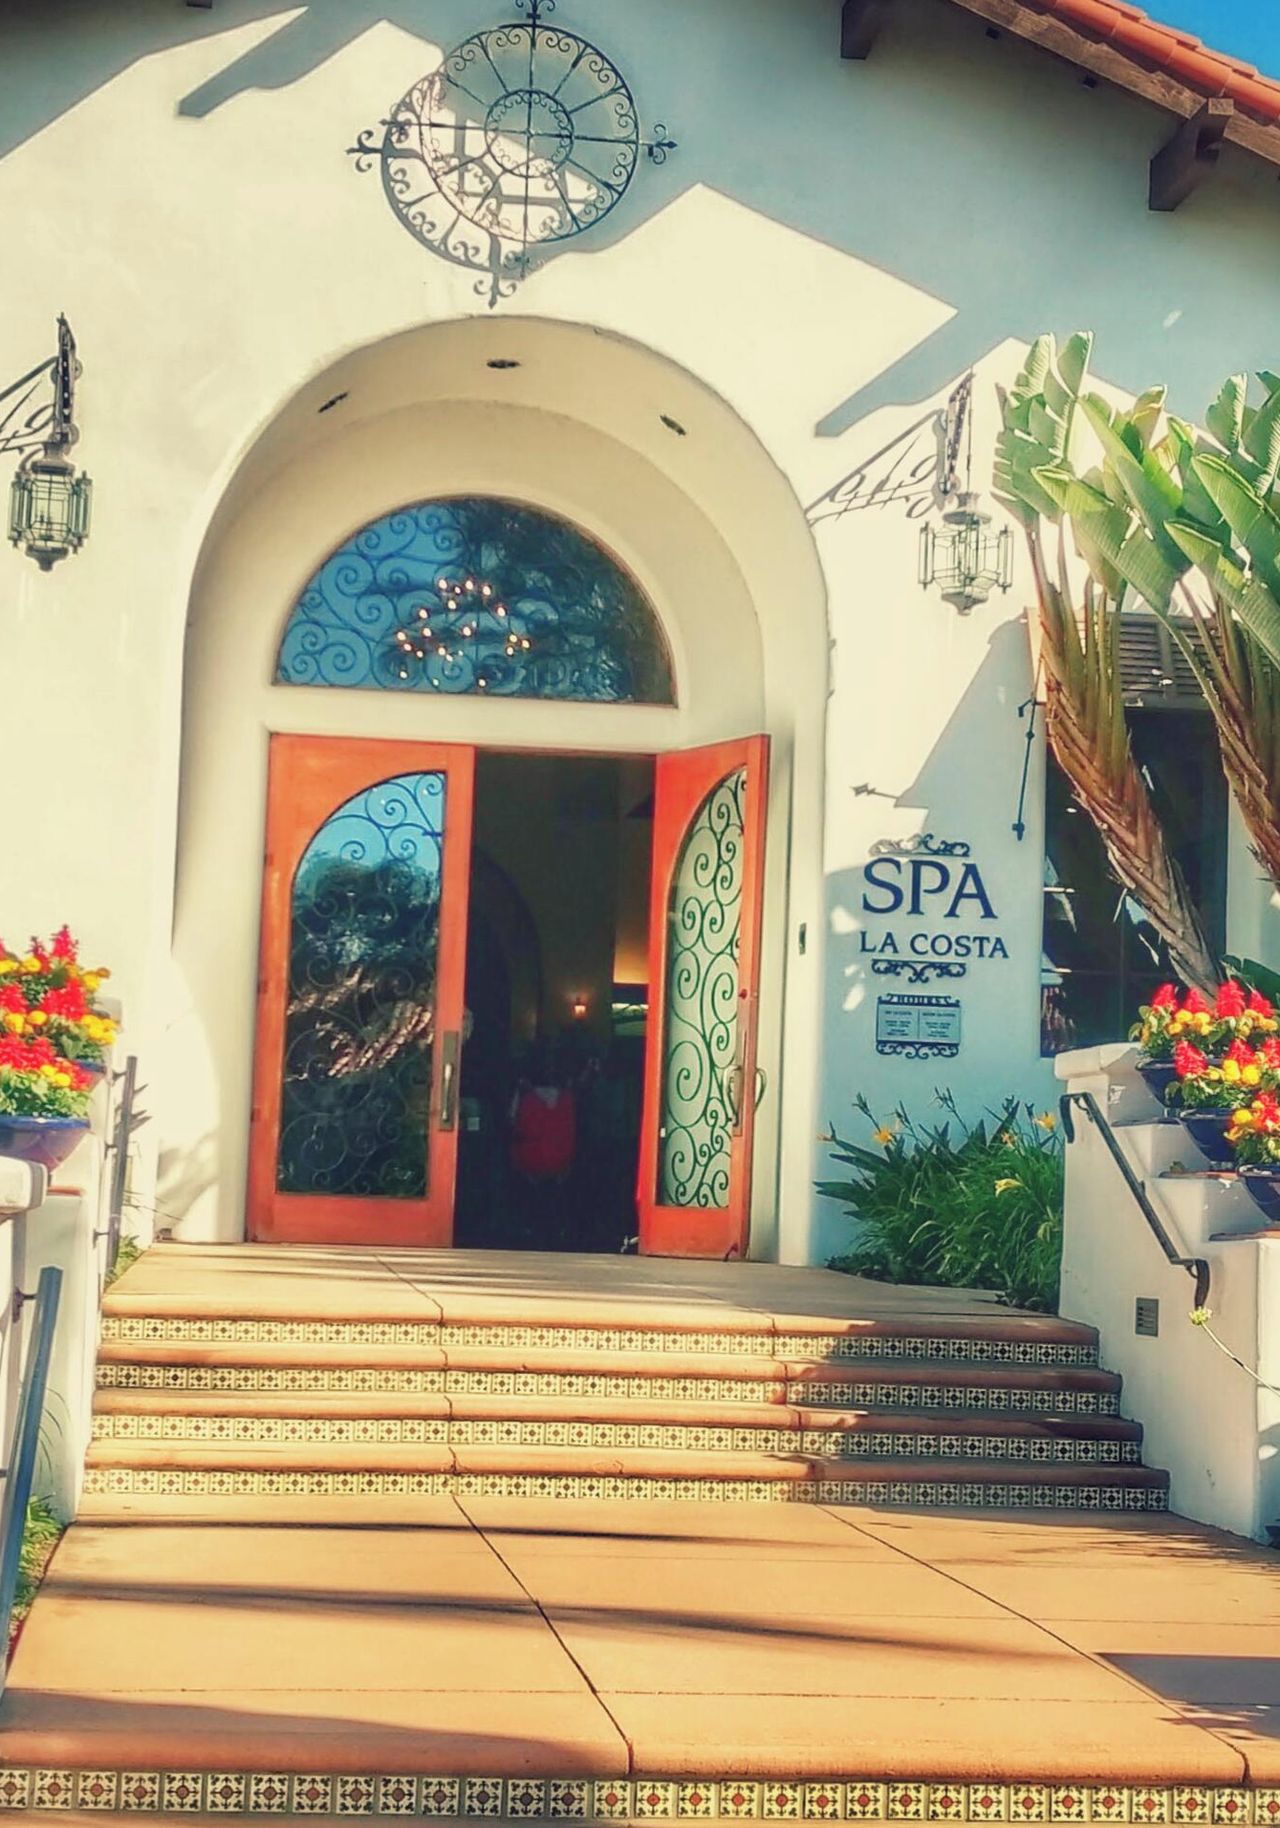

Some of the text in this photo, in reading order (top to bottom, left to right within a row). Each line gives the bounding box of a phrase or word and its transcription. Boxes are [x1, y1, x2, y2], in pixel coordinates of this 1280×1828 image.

[862, 857, 998, 919] SPA
[860, 931, 1009, 959] LA COSTA
